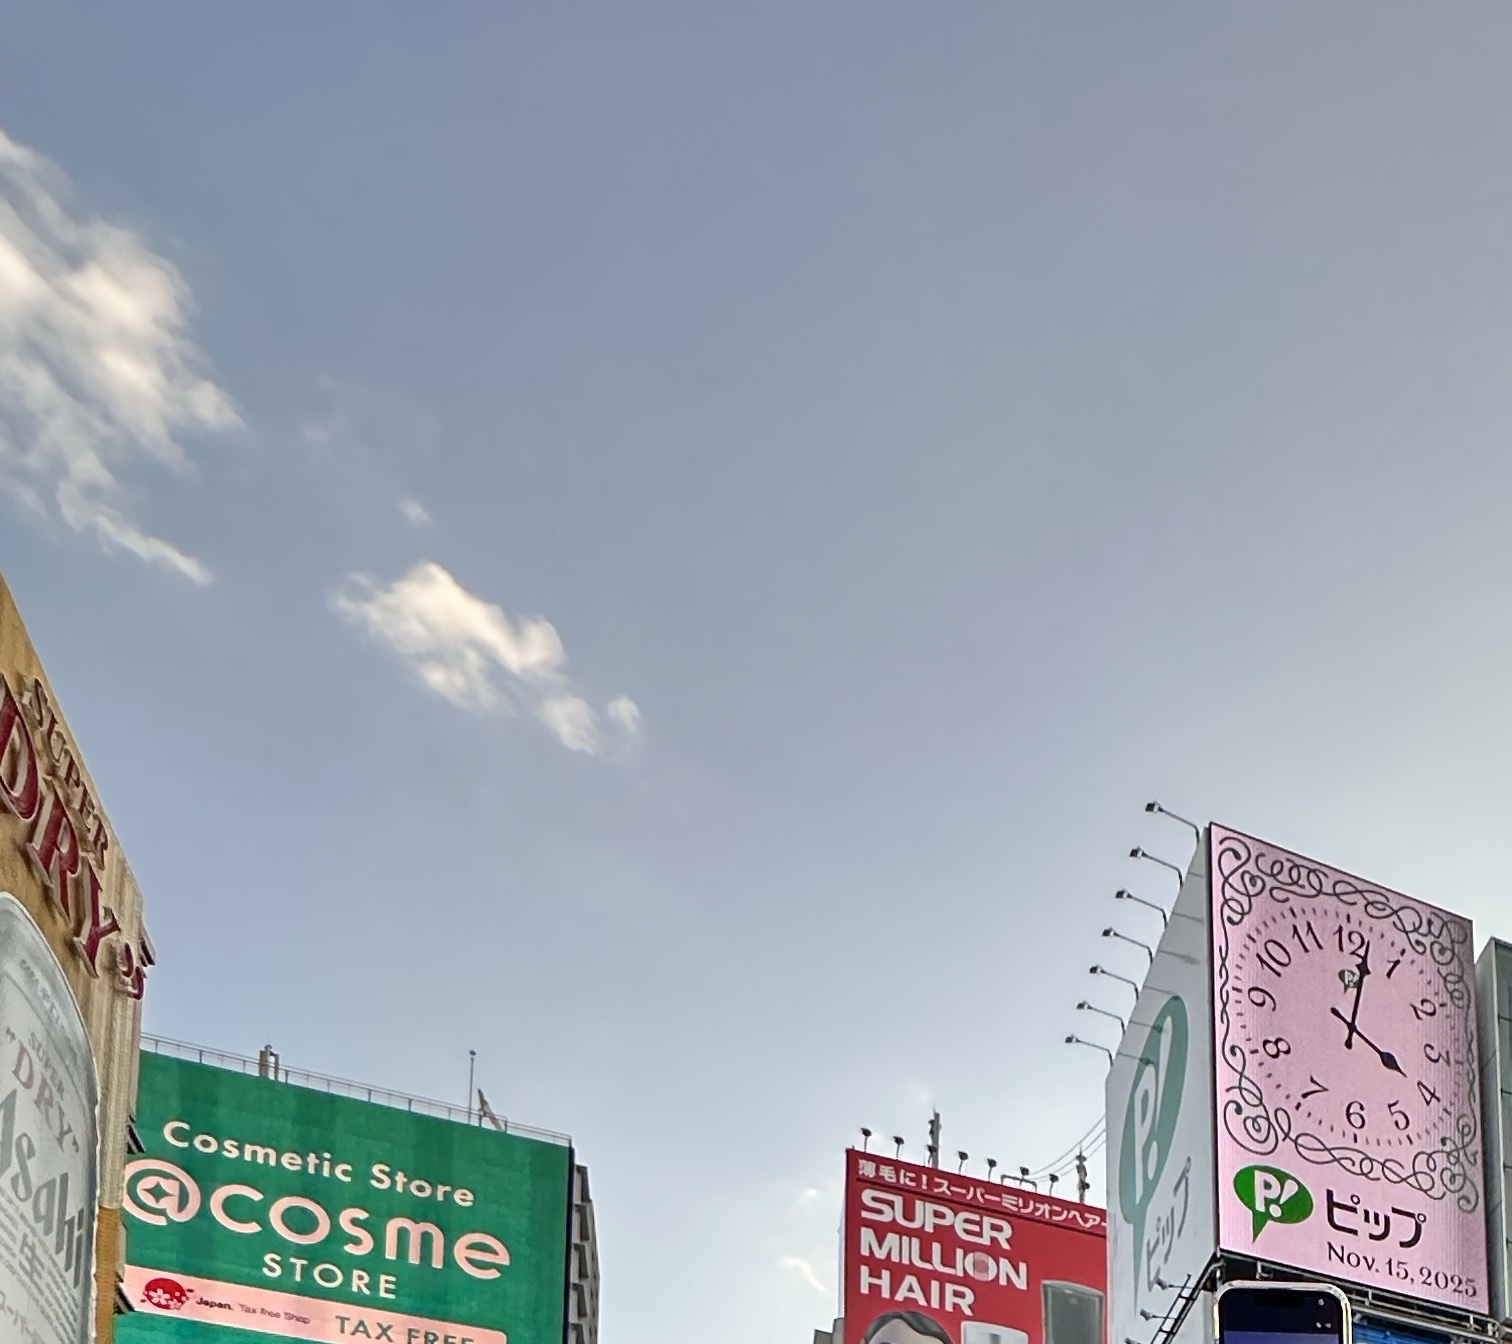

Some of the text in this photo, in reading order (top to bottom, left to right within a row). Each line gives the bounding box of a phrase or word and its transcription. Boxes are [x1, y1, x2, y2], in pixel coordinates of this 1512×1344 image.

[1292, 921, 1324, 953] 11
[1333, 925, 1368, 958] 12
[1255, 939, 1293, 977] 10
[1385, 958, 1401, 980] 1
[1247, 986, 1277, 1012] 9
[1410, 998, 1437, 1021] 2
[1262, 1037, 1291, 1060] 8
[1423, 1043, 1451, 1067] 3
[1301, 1076, 1329, 1100] 7
[1418, 1080, 1442, 1107] 4
[1346, 1101, 1366, 1130] 6
[1388, 1101, 1410, 1130] 5
[163, 1120, 475, 1207] Cosmetic Store
[123, 1159, 510, 1279] @cosme
[861, 1189, 1013, 1250] SUPER
[1326, 1189, 1427, 1249] ピップ
[860, 1227, 1028, 1290] MILLION
[263, 1254, 397, 1299] STORE
[860, 1265, 975, 1317] HAIR
[1419, 1266, 1477, 1298] 2025
[335, 1315, 394, 1343] TAX
